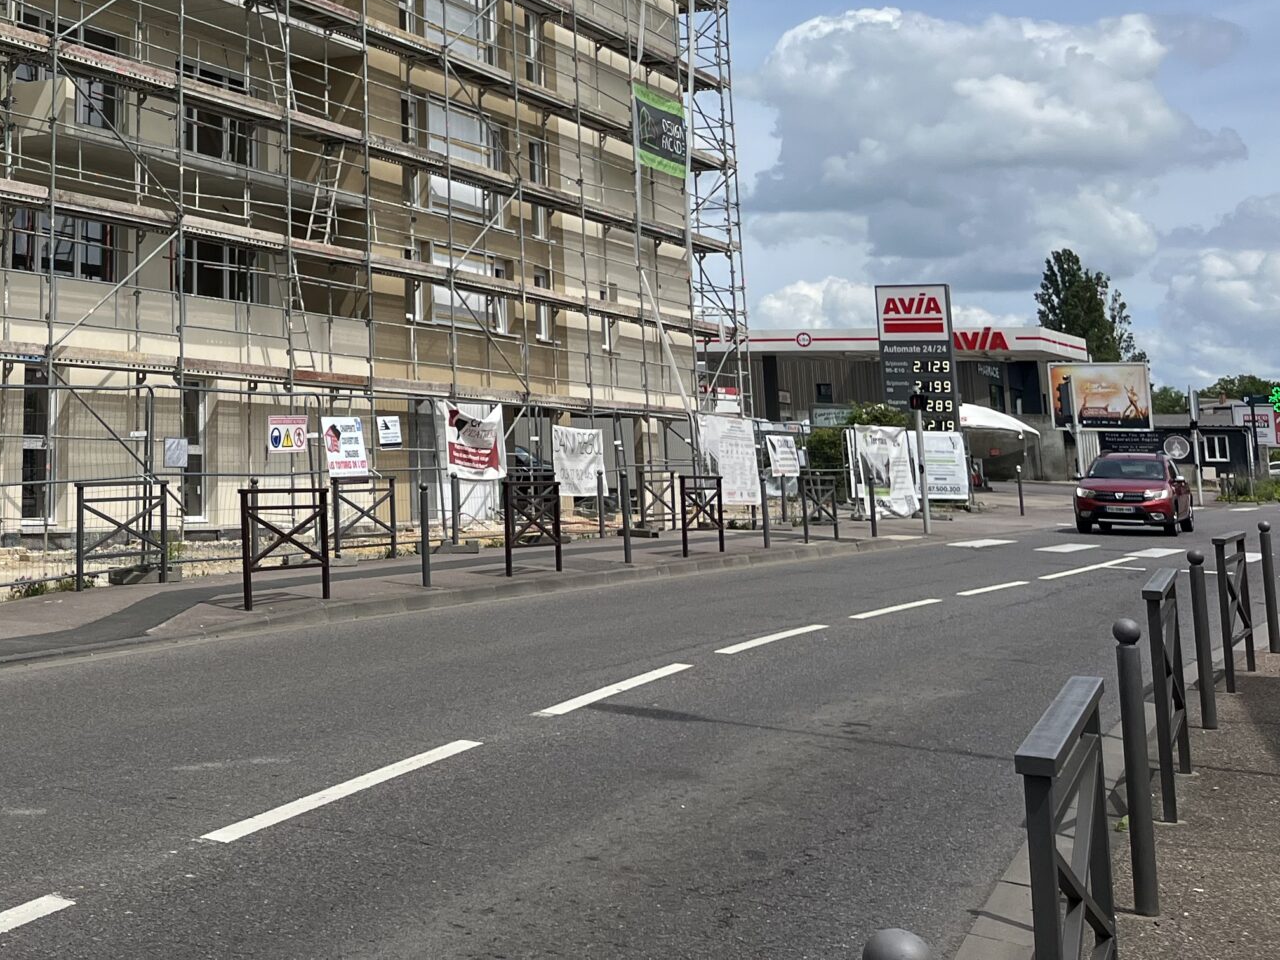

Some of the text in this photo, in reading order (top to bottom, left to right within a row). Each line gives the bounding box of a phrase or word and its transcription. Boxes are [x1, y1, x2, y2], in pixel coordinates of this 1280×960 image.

[883, 293, 942, 315] AVIA
[884, 345, 947, 353] Automate 24/24
[913, 360, 950, 373] 2.129
[926, 400, 953, 412] 289
